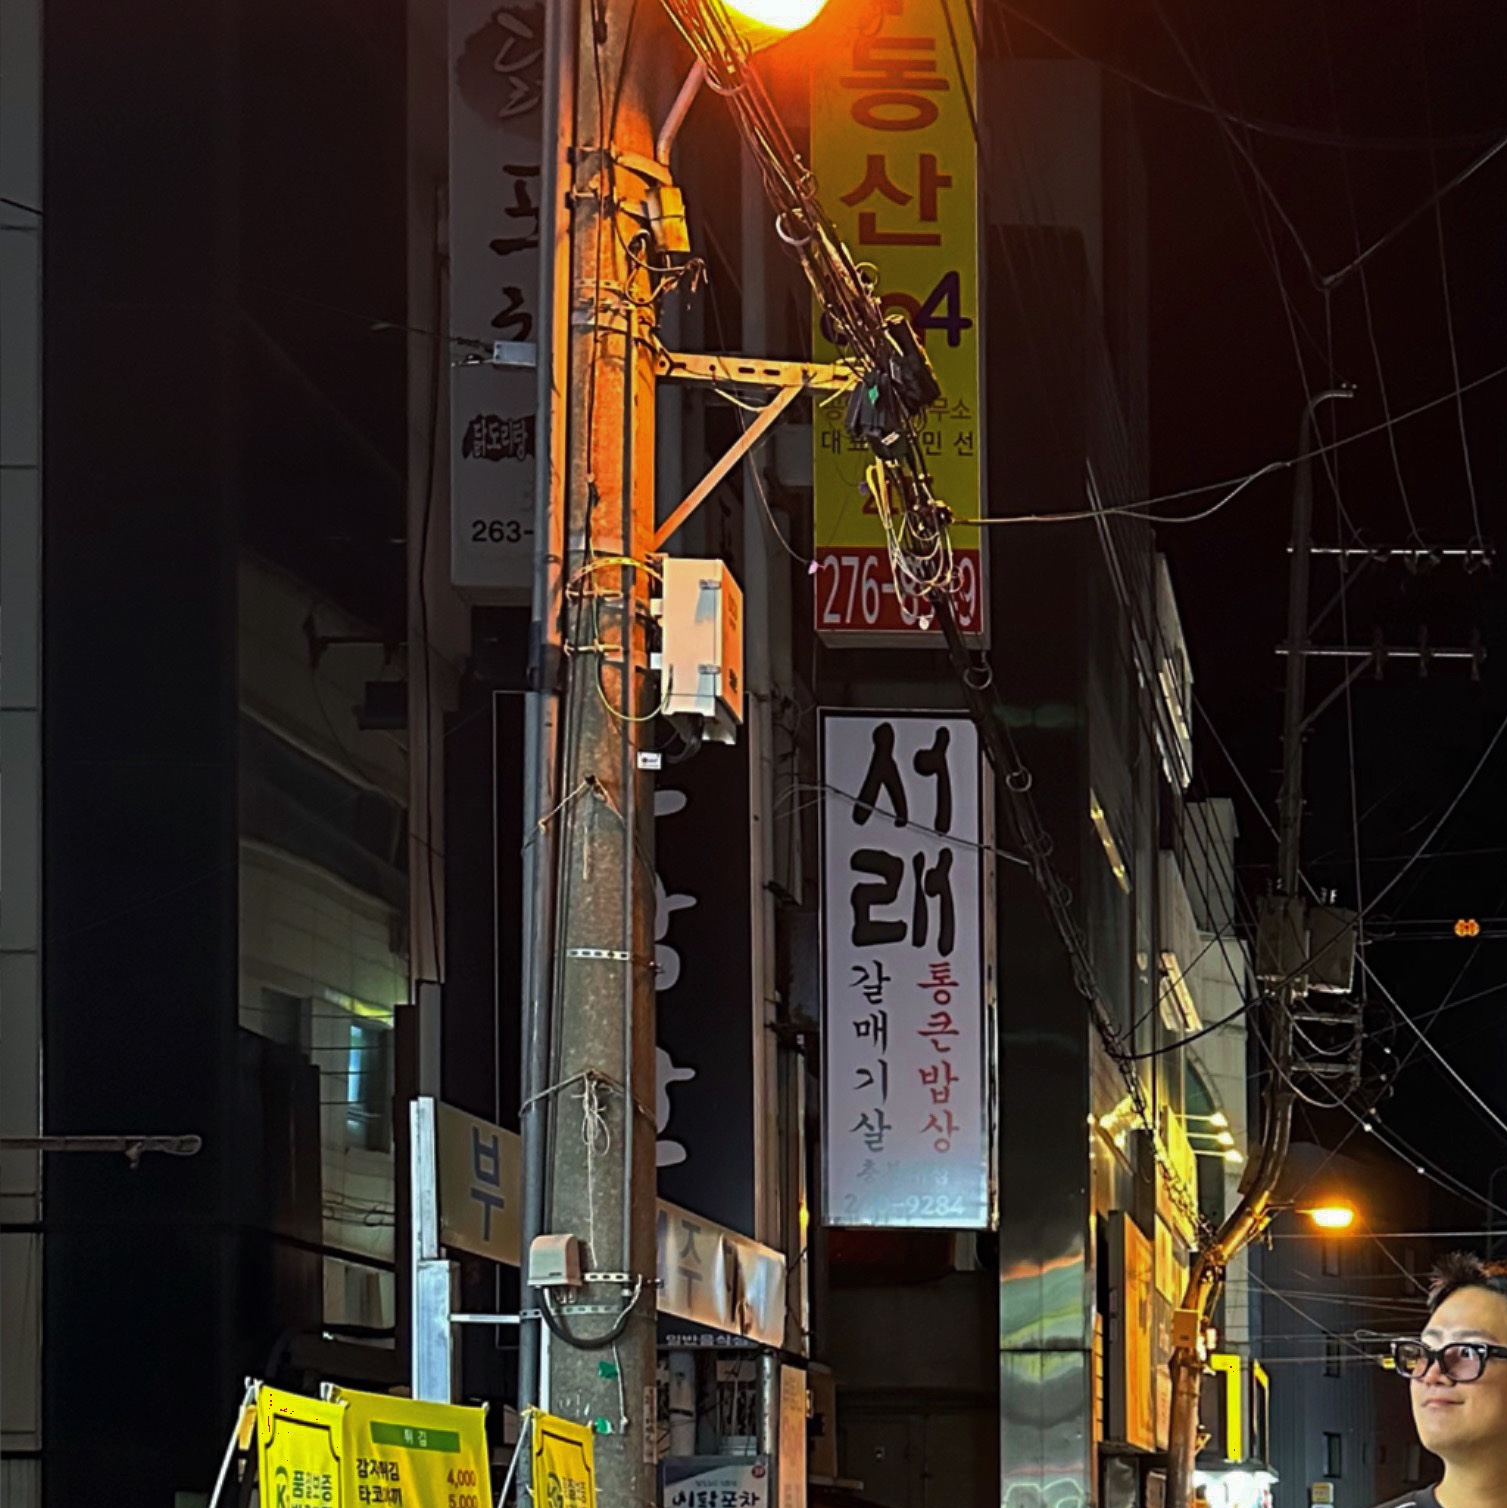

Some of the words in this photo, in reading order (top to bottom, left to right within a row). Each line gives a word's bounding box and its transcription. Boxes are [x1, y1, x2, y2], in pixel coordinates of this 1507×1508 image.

[840, 0, 953, 246] 동산
[851, 722, 955, 957] 서래
[850, 960, 892, 1153] 갈매기살
[917, 961, 960, 1154] 통큰밥상
[447, 1468, 476, 1488] 4,000
